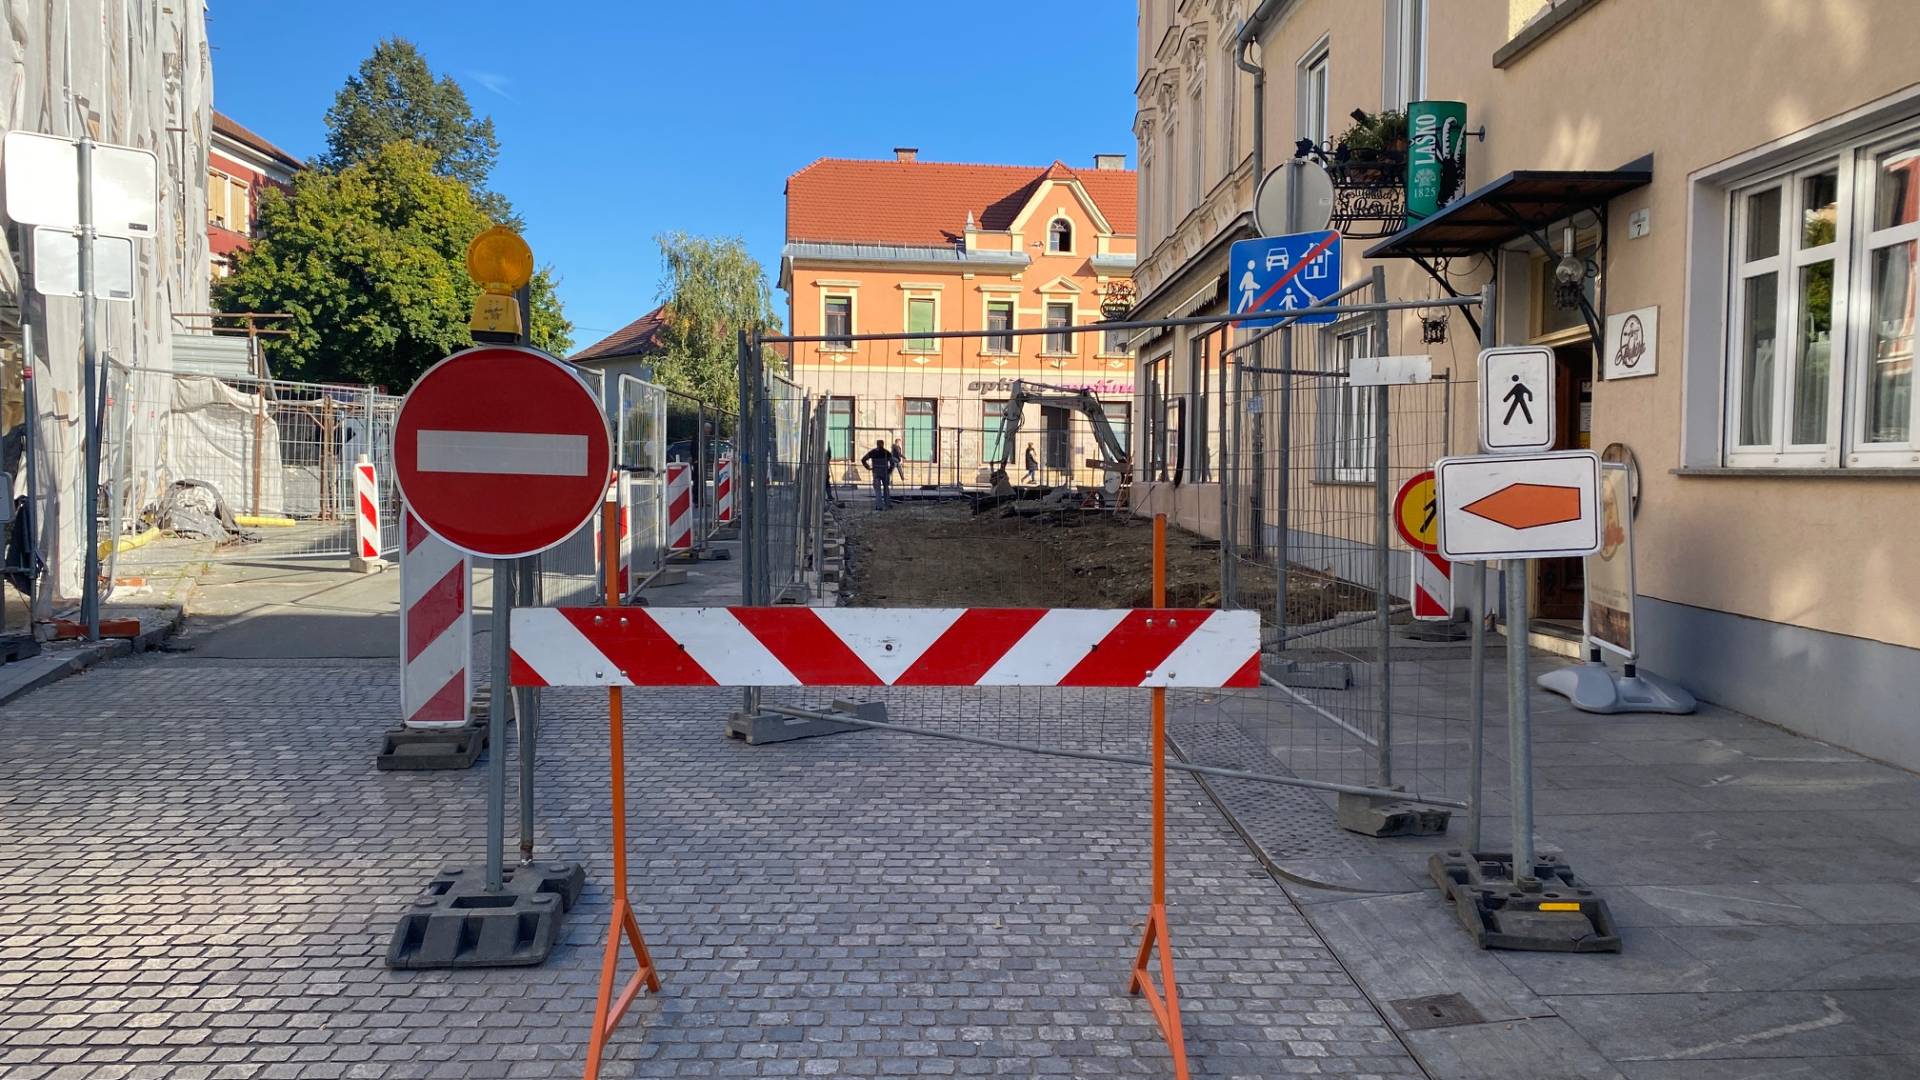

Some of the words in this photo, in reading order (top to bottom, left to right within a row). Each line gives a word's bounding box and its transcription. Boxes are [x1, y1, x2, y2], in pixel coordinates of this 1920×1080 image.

[1409, 114, 1437, 165] LAŠKO
[1414, 187, 1436, 199] 1825
[1636, 223, 1642, 236] 7
